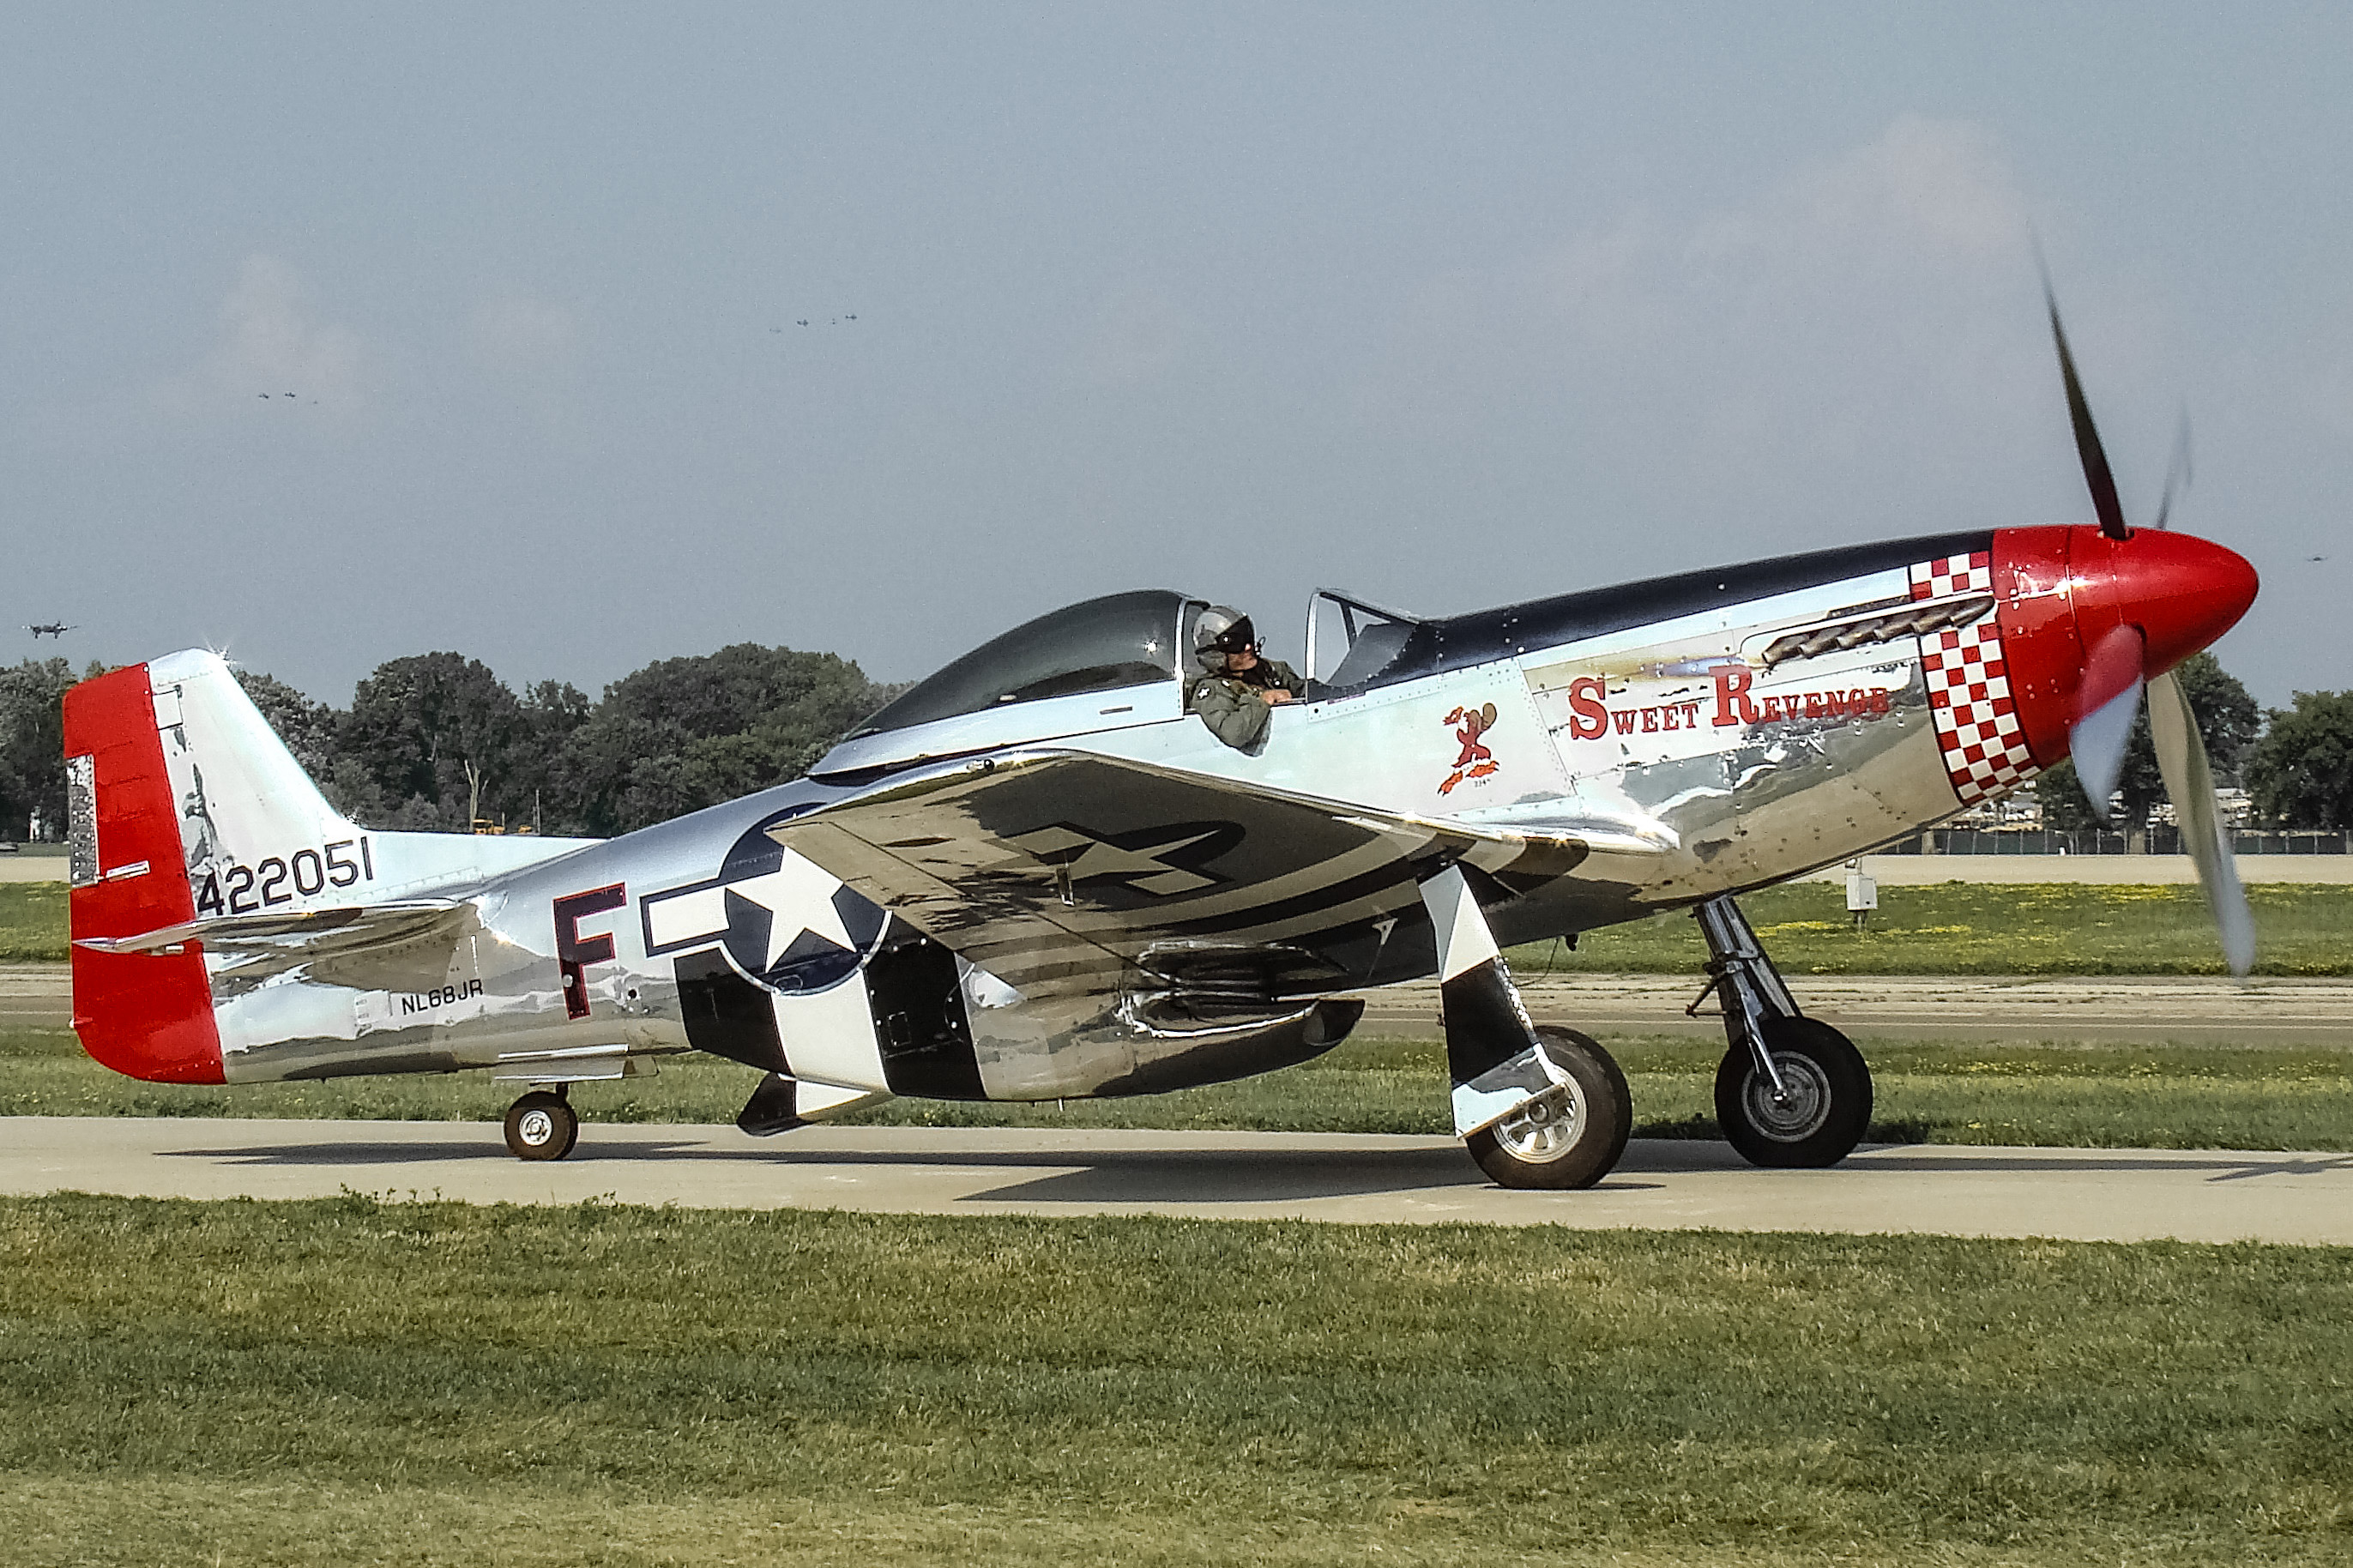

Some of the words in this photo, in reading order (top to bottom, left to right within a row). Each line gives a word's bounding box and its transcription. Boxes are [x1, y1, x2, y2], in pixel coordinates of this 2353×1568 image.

[1569, 677, 1698, 740] SWEET
[1709, 665, 1888, 727] REVENGE
[197, 835, 373, 916] 422051
[553, 882, 627, 1020] F
[401, 979, 484, 1016] NL68JR
